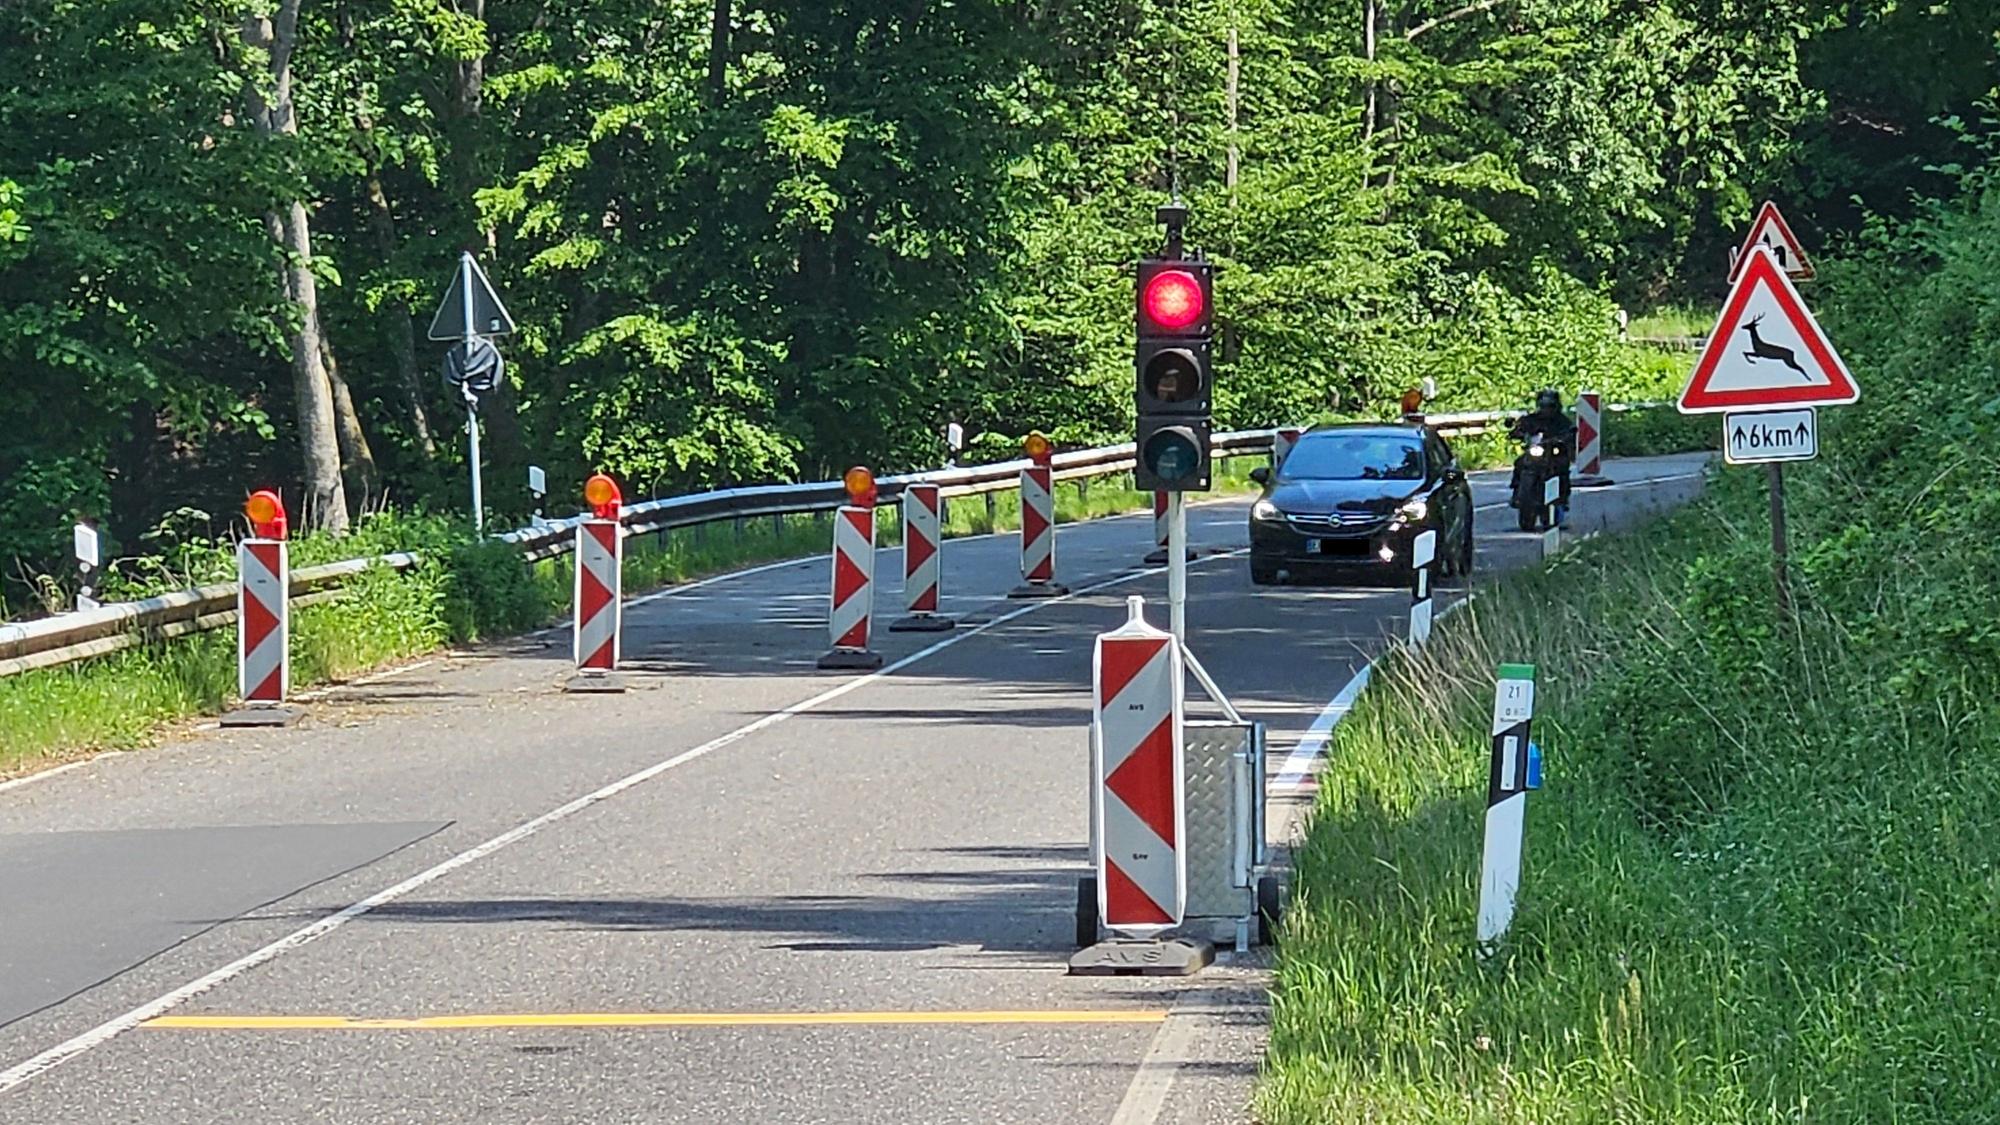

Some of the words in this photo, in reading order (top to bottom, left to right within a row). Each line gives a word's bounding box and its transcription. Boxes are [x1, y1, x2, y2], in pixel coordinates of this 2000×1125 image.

[1508, 686, 1520, 699] 21
[1128, 703, 1145, 711] AVS
[1094, 950, 1162, 963] AVS
